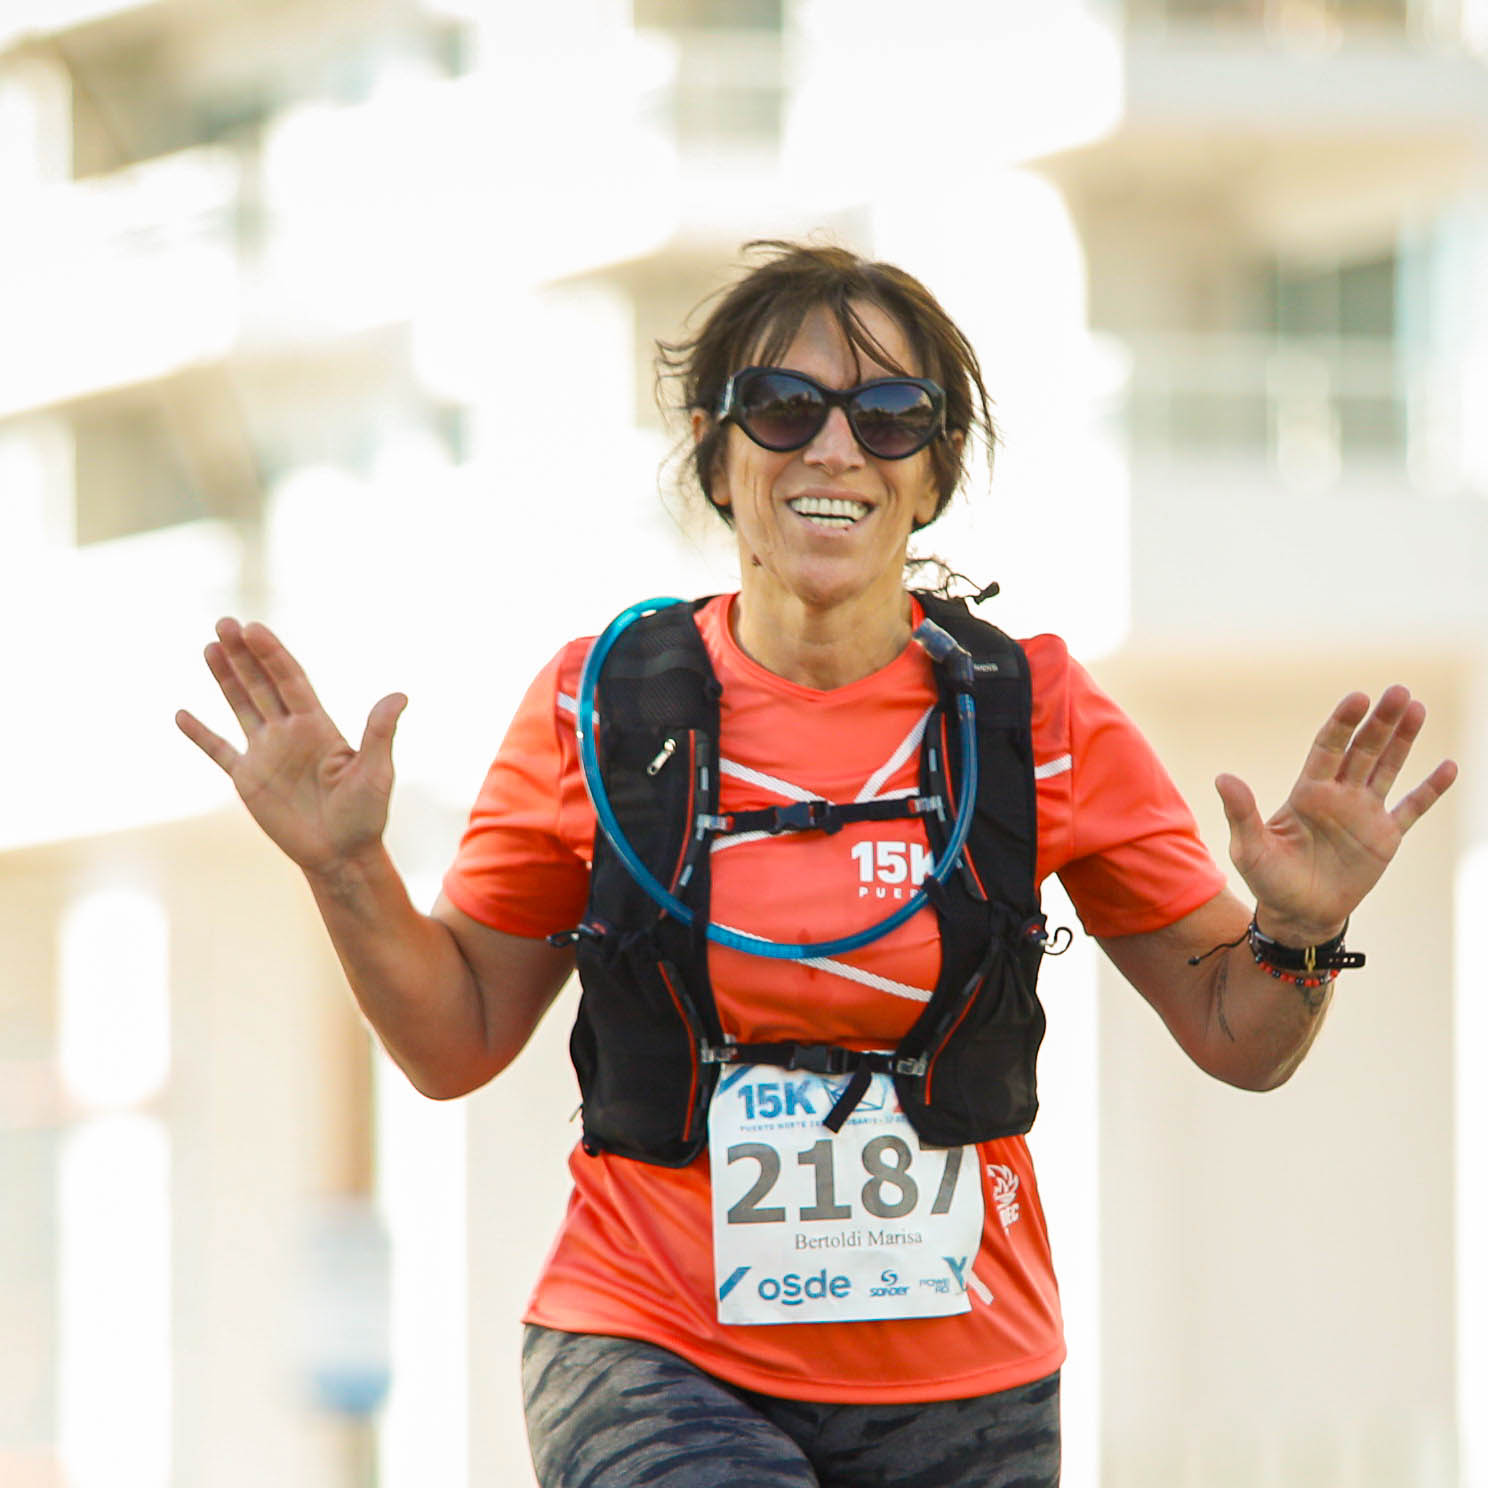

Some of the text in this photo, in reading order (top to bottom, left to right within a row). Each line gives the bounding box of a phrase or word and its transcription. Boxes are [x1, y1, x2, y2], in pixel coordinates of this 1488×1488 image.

[738, 1081, 817, 1120] 15K
[726, 1134, 963, 1225] 2187
[795, 1228, 923, 1251] Bertoldi Marisa
[758, 1268, 852, 1306] osde
